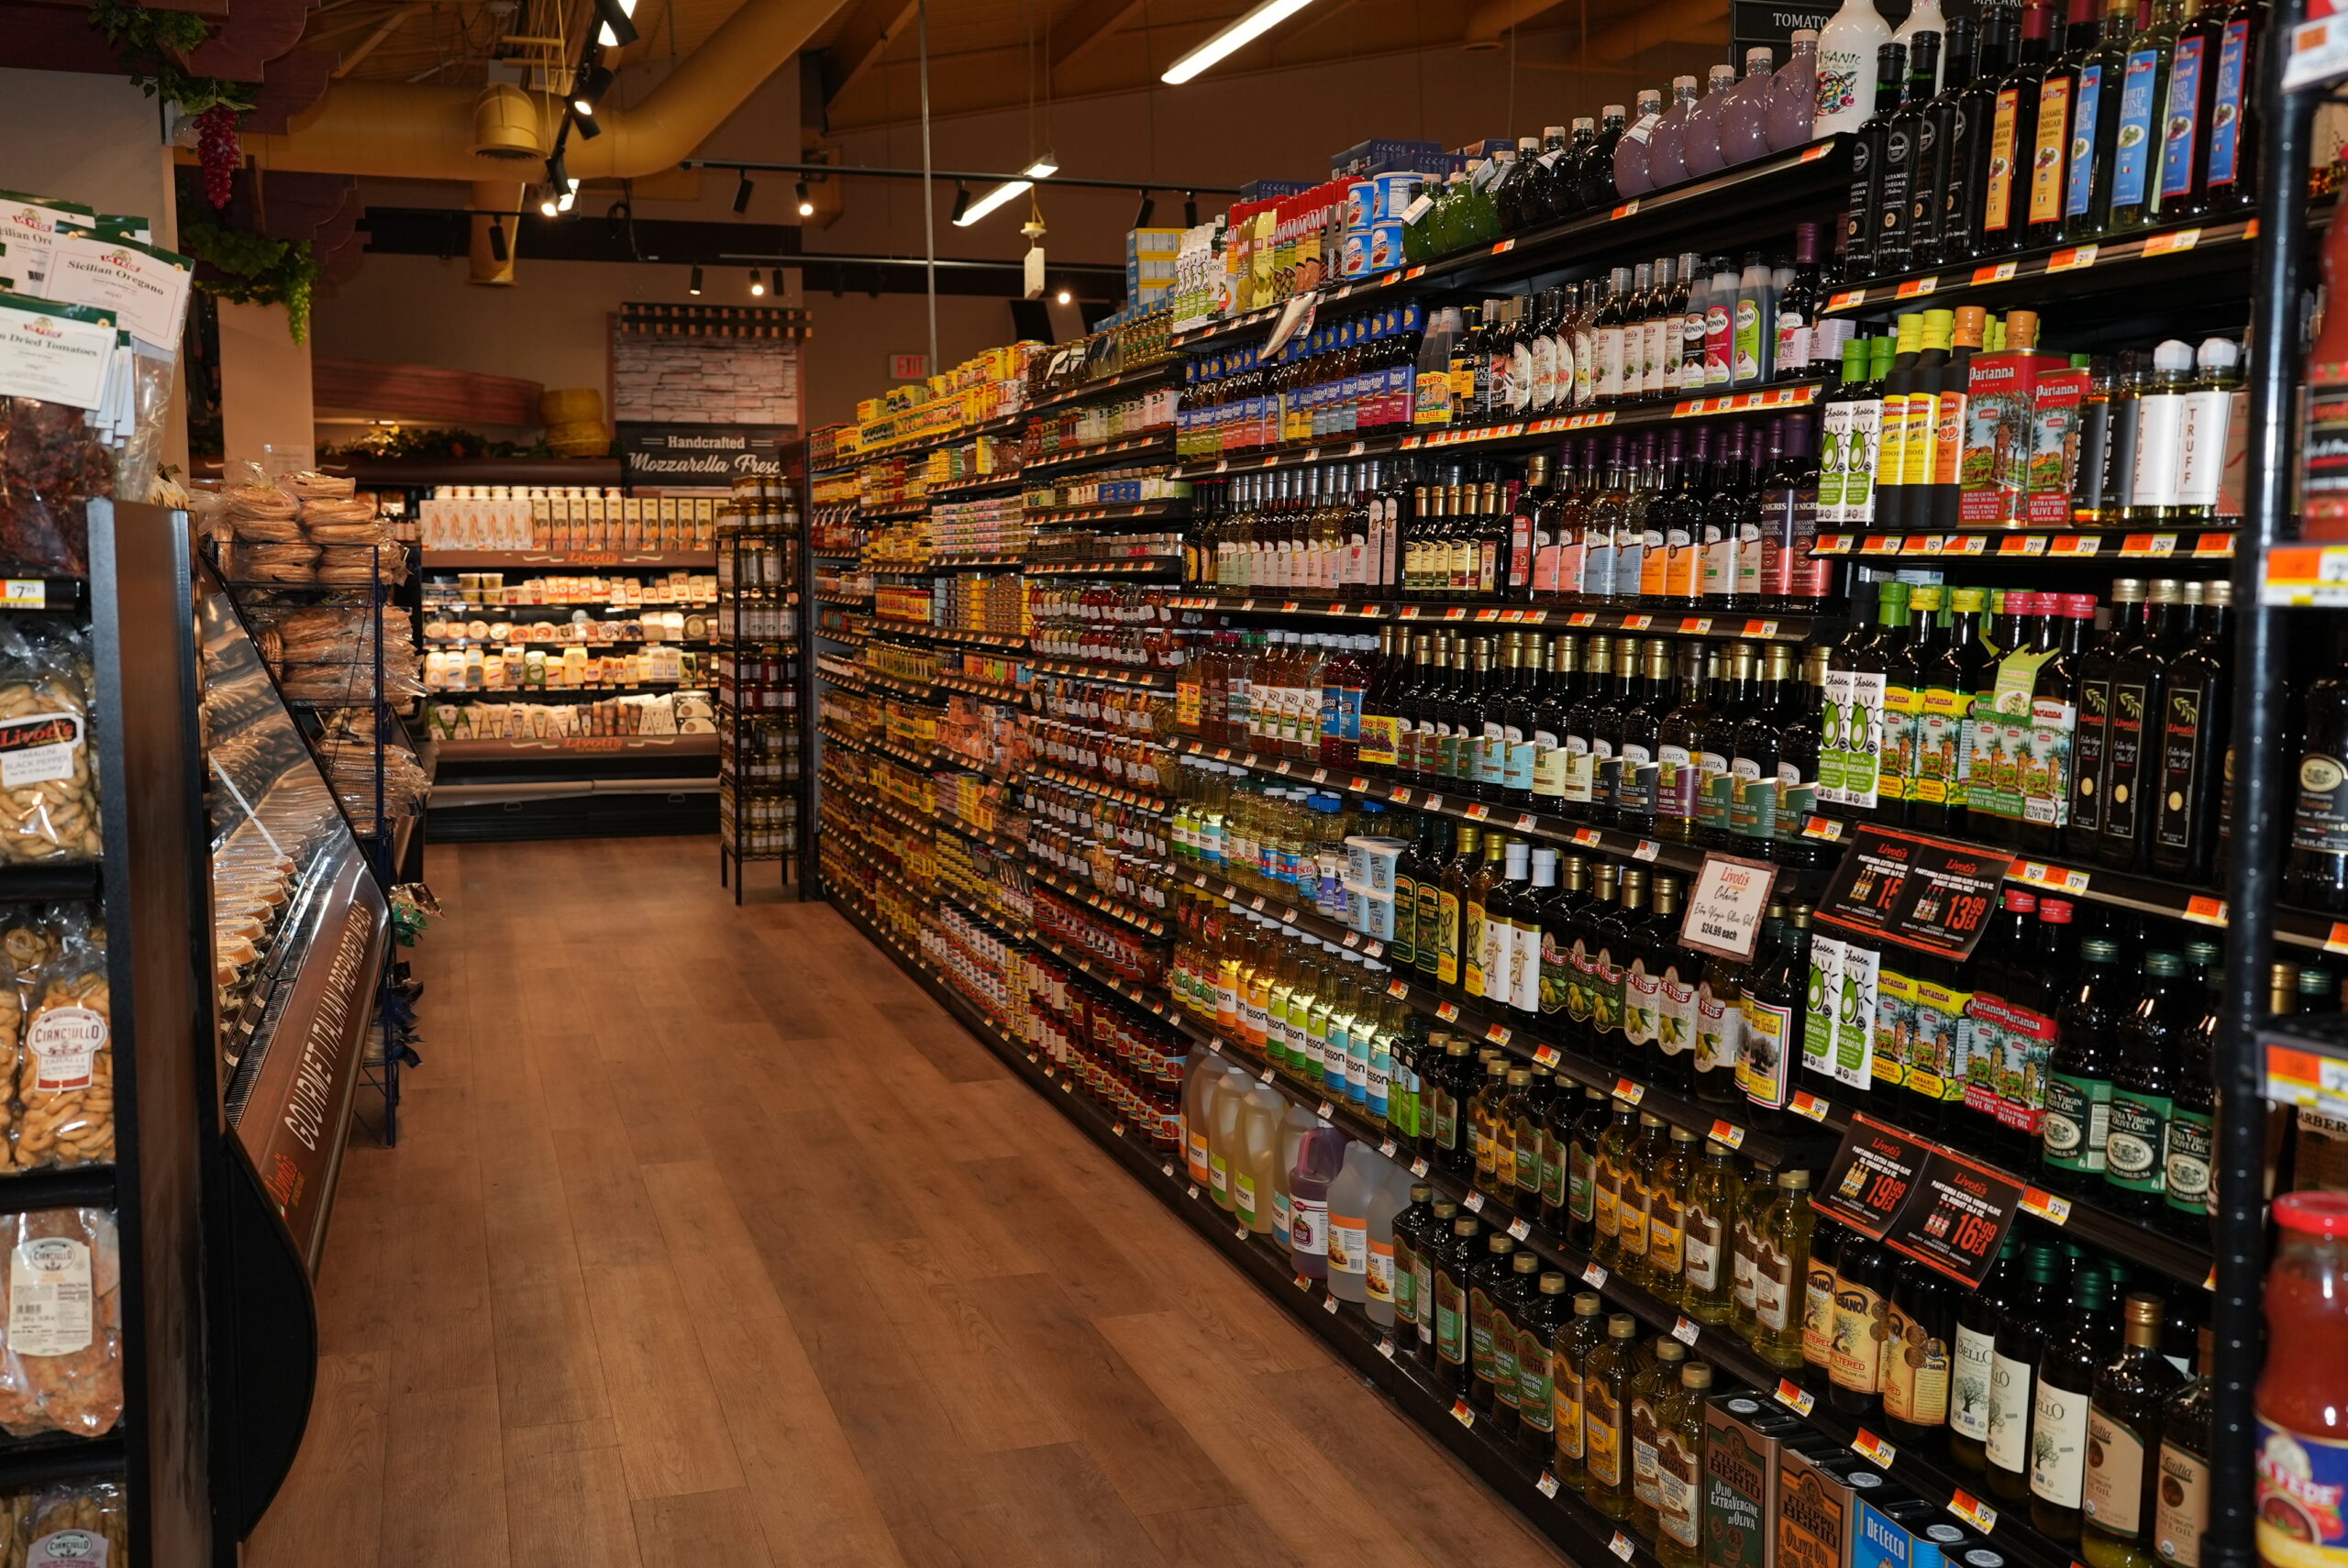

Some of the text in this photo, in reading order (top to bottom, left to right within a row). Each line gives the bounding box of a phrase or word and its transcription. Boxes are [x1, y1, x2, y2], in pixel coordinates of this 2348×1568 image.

[0, 226, 29, 241] cilian
[68, 260, 163, 295] Sicilian Oregano
[1737, 313, 1754, 323] ONINI
[10, 332, 97, 357] Dried Tomatoes
[897, 356, 925, 377] EXIT
[1969, 367, 2015, 386] Partanna
[2036, 385, 2079, 402] Partanna
[668, 436, 746, 449] Handcrafted
[2185, 409, 2197, 484] TRUFF
[2072, 419, 2084, 491] TRUFF
[2102, 415, 2114, 489] TRUFF
[628, 453, 781, 474] Mozzarella Fresc
[2031, 506, 2065, 516] OLIVE OIL
[2168, 723, 2195, 734] Livoti's
[1877, 843, 1909, 859] Livoti's
[1945, 858, 1978, 874] Livoti's
[1396, 878, 1411, 889] CENTO
[1720, 867, 1752, 886] Livoti's
[1420, 889, 1434, 898] CENTO
[1700, 922, 1738, 941] $24.99 each
[1964, 915, 1979, 932] EA
[1546, 952, 1566, 966] FEDE
[1577, 958, 1595, 975] FEDE
[1601, 966, 1621, 985] FEDE
[1635, 980, 1656, 994] FEDE
[1668, 987, 1689, 1003] FEDE
[1918, 983, 1950, 1003] Partanna
[1247, 1008, 1268, 1021] esson
[1700, 1002, 1722, 1019] FEDE
[1971, 998, 2006, 1016] Partanna
[284, 1041, 332, 1152] GOURMET
[328, 927, 366, 996] PREPARED
[349, 900, 372, 942] MEALS
[1268, 1020, 1286, 1031] esson
[2005, 1009, 2041, 1031] Partanna
[35, 1024, 99, 1043] CIANCIULLO
[1286, 1029, 1304, 1041] esson
[1324, 1049, 1345, 1063] esson
[1346, 1060, 1365, 1074] esson
[1368, 1071, 1389, 1086] esson
[2056, 1092, 2083, 1108] VIRGIN
[2061, 1100, 2075, 1113] OIL
[1998, 1110, 2028, 1130] OLIVE OIL
[2112, 1117, 2147, 1132] OLIVE OIL
[2127, 1111, 2155, 1126] VIRGIN
[2298, 1110, 2348, 1133] ARBER
[1871, 1137, 1901, 1157] Livoti's
[2191, 1140, 2207, 1154] OIL
[1954, 1172, 1988, 1196] Livoti's
[1881, 1195, 1897, 1212] EA
[1971, 1236, 1988, 1257] EA
[1957, 1340, 1993, 1365] BELLO
[1714, 1448, 1758, 1484] FILIPPO
[1710, 1455, 1761, 1501] BERIO
[2276, 1464, 2335, 1507] FEDE
[1715, 1479, 1732, 1497] OLIO
[1788, 1494, 1834, 1533] FILIPPO
[1782, 1500, 1836, 1551] BERIO
[1785, 1523, 1829, 1567] OLIVE OIL
